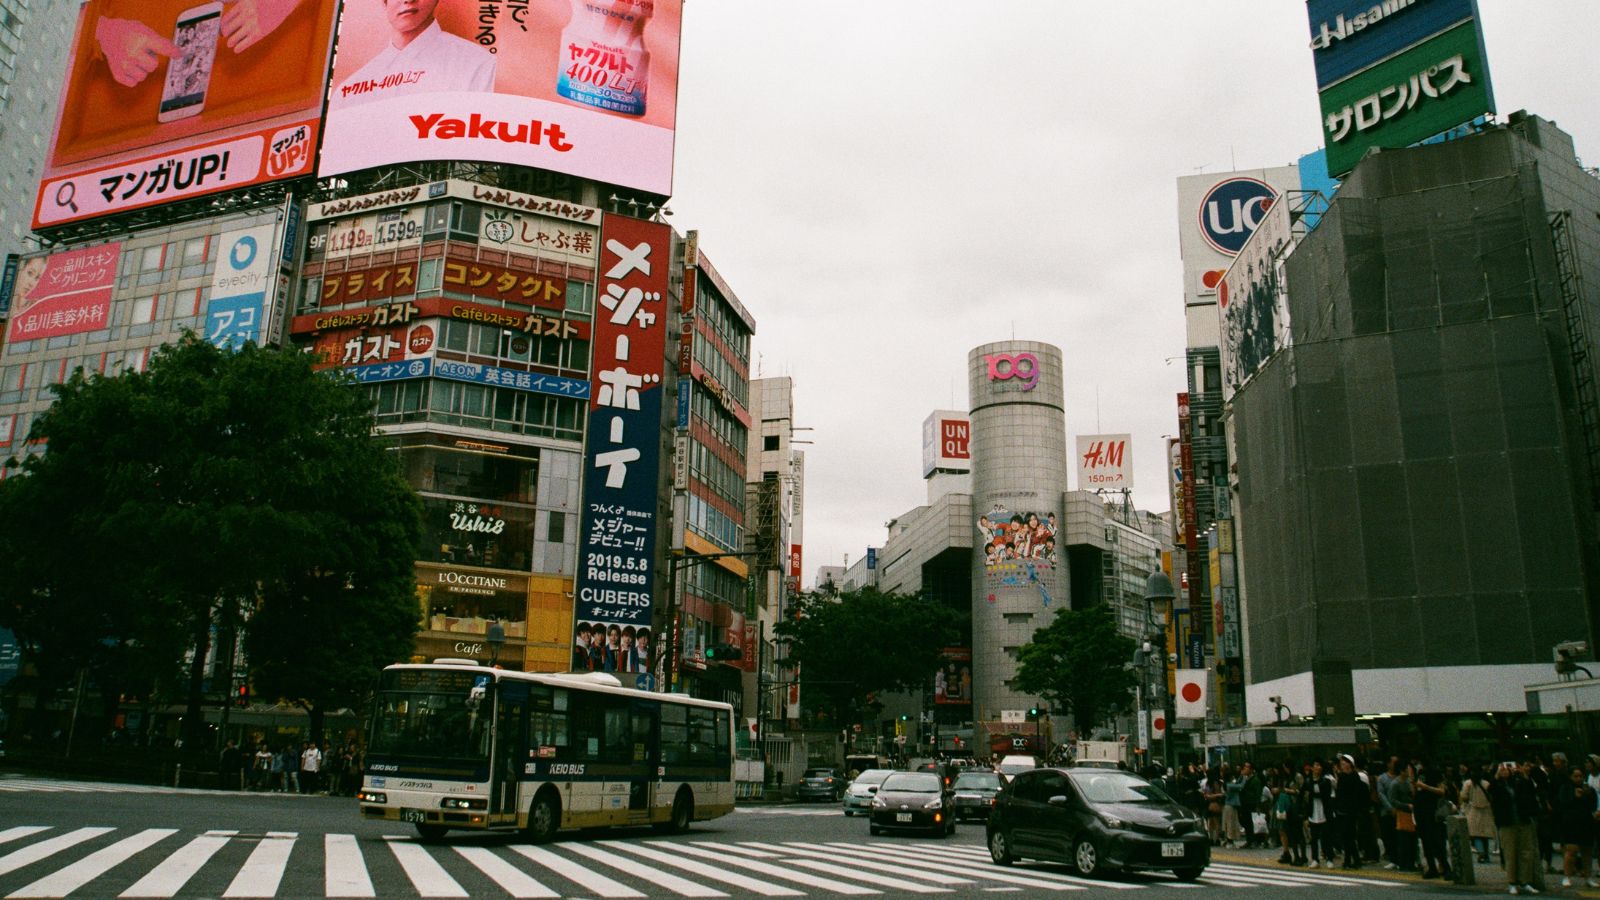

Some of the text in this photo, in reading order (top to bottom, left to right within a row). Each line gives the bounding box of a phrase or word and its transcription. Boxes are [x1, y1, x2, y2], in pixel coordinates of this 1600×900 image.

[568, 42, 634, 75] ヤクルト
[1325, 54, 1472, 143] サロンパス
[272, 126, 307, 154] マンガ
[408, 113, 574, 152] Yakult
[269, 139, 310, 176] UP!
[100, 150, 230, 204] マンガUP!
[321, 187, 421, 217] しゃぶしゃぶバイキング
[473, 185, 596, 221] しゃぶしゃぶバイキング
[309, 234, 327, 249] 9F
[521, 221, 593, 254] しゃぶ葉
[62, 250, 115, 273] 品川スキン
[61, 268, 107, 289] クリニック
[218, 271, 262, 289] eyecity
[324, 266, 414, 299] プライス
[444, 262, 562, 301] コンタクト
[23, 303, 104, 332] 品川美容外科
[372, 302, 419, 326] ガスト
[523, 314, 578, 340] ガスト
[342, 334, 401, 364] ガスト
[595, 238, 661, 489] メジャーボーイ
[440, 363, 588, 395] AEON 英会話イーオン
[983, 352, 1040, 390] 109
[945, 424, 967, 439] UN
[1083, 440, 1125, 469] H&M
[592, 517, 648, 533] メジャー
[587, 553, 648, 571] 2019.5.8
[587, 567, 647, 584] Release
[580, 587, 650, 607] CUBERS
[591, 607, 642, 619] キューバーズ
[454, 641, 482, 656] Café
[549, 763, 585, 775] KEIO BUS
